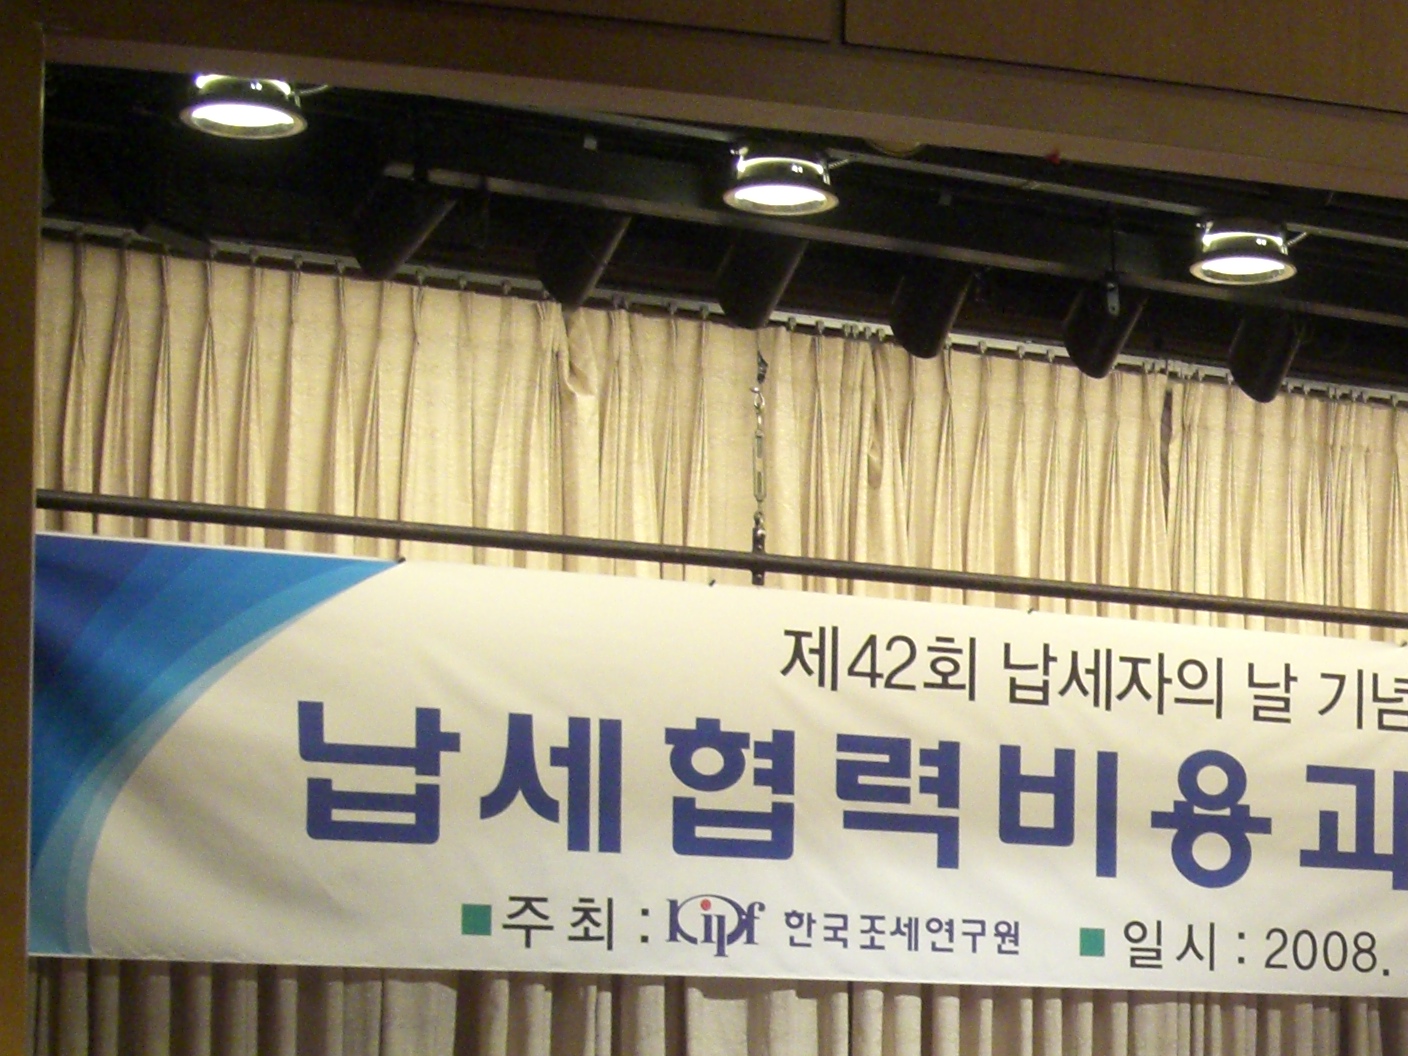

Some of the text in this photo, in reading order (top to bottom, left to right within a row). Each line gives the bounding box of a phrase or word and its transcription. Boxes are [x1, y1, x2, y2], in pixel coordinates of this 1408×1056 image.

[779, 625, 977, 702] 제42회
[1003, 642, 1223, 720] 납세자의
[1247, 662, 1299, 724] 날
[784, 909, 1020, 956] 한국조세연구원
